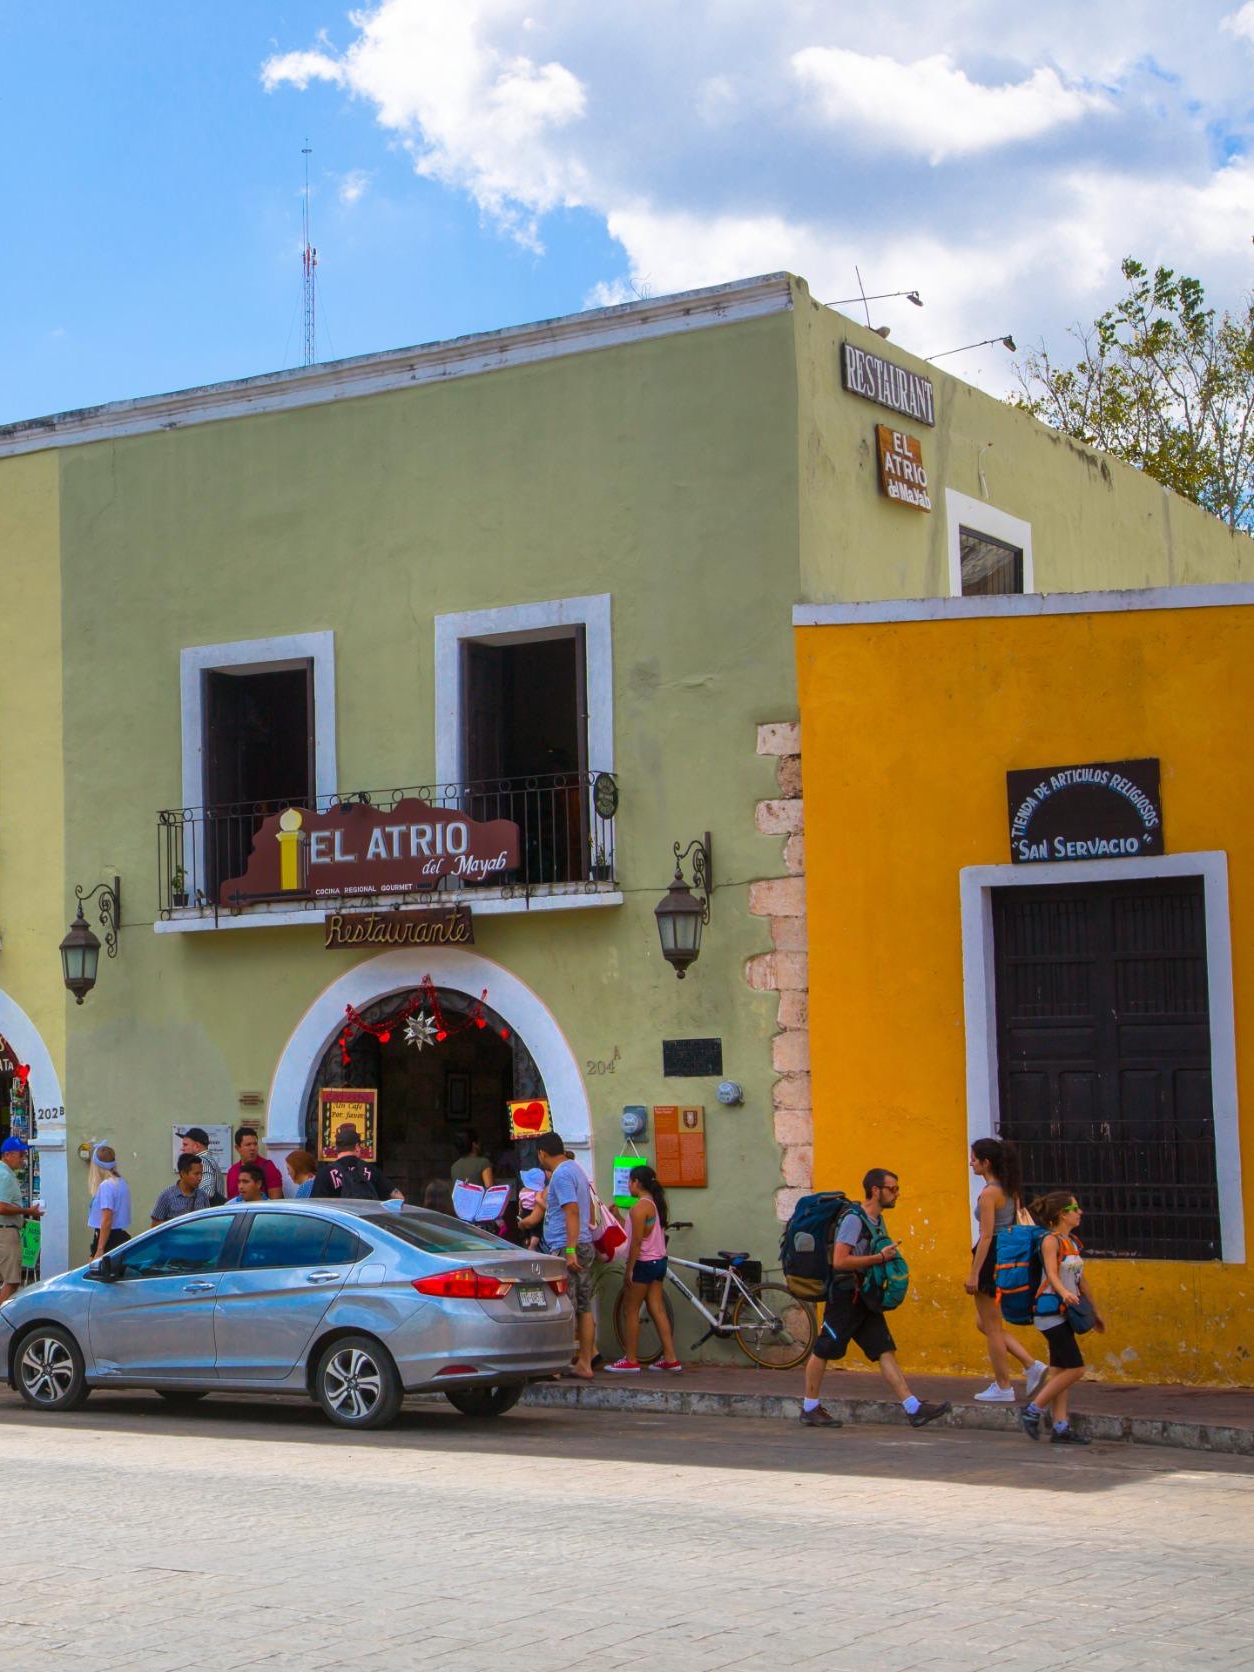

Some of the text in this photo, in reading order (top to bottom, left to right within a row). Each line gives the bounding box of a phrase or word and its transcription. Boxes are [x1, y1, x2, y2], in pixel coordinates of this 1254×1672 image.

[845, 345, 934, 424] RESTAURANT
[893, 431, 913, 458] EL
[884, 451, 928, 488] ATRIO
[888, 478, 899, 498] del
[1011, 767, 1159, 838] TIENDA DE ARTICULOS RELIGIOSOS
[310, 821, 469, 864] EL ATRIO
[422, 850, 508, 880] del Mayab
[315, 882, 414, 895] COCINA REGIONAL GOURMET
[325, 912, 470, 949] Restaurante
